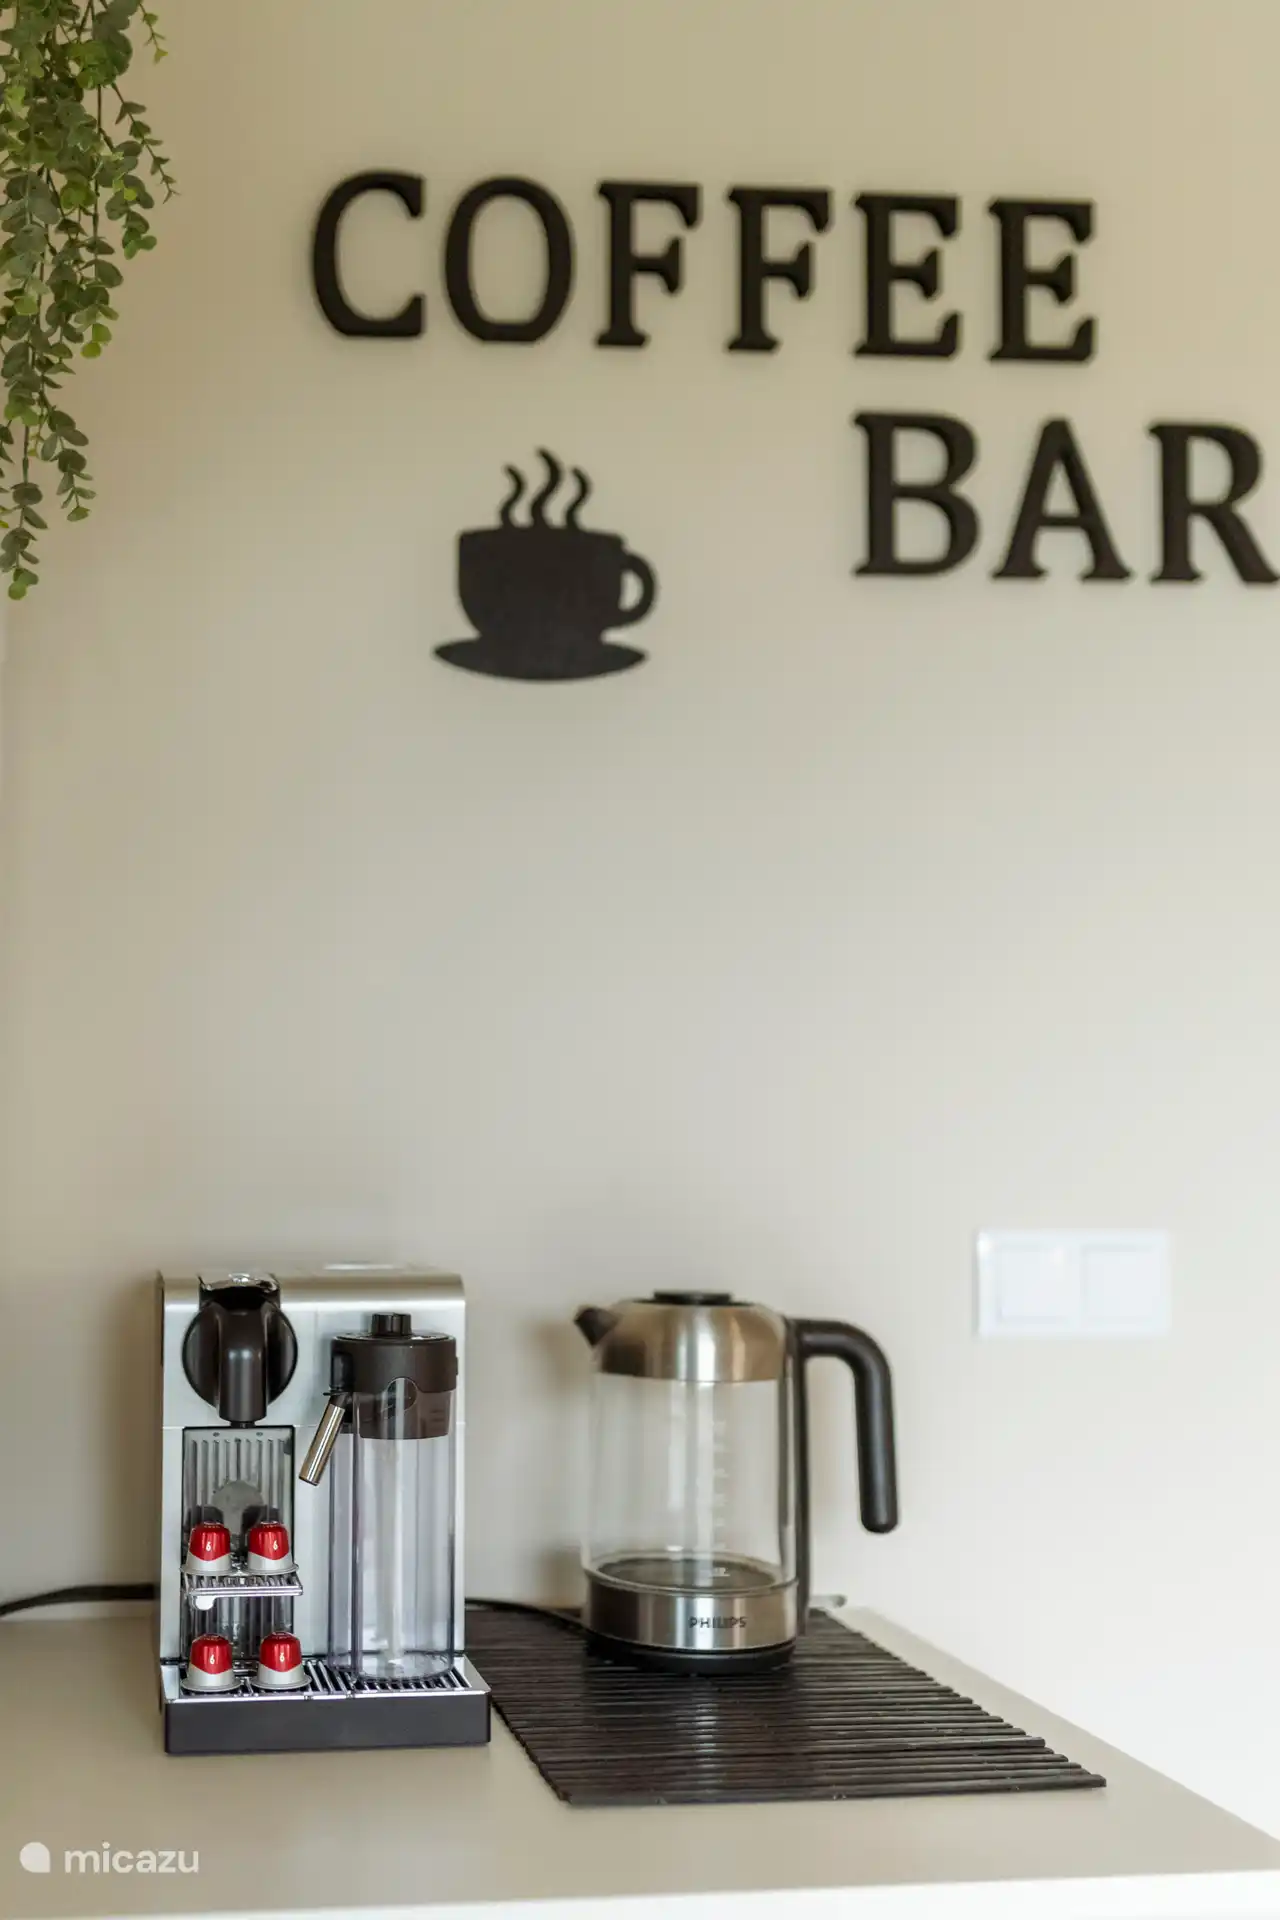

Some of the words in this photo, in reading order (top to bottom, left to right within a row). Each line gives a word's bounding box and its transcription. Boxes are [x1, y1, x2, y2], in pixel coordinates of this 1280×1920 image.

[310, 170, 1095, 363] COFFEE
[853, 411, 1280, 584] BAR
[205, 1541, 212, 1552] 6
[273, 1540, 279, 1551] 6
[688, 1615, 747, 1629] PHILIPS
[209, 1654, 216, 1665] 6
[280, 1652, 286, 1663] 6
